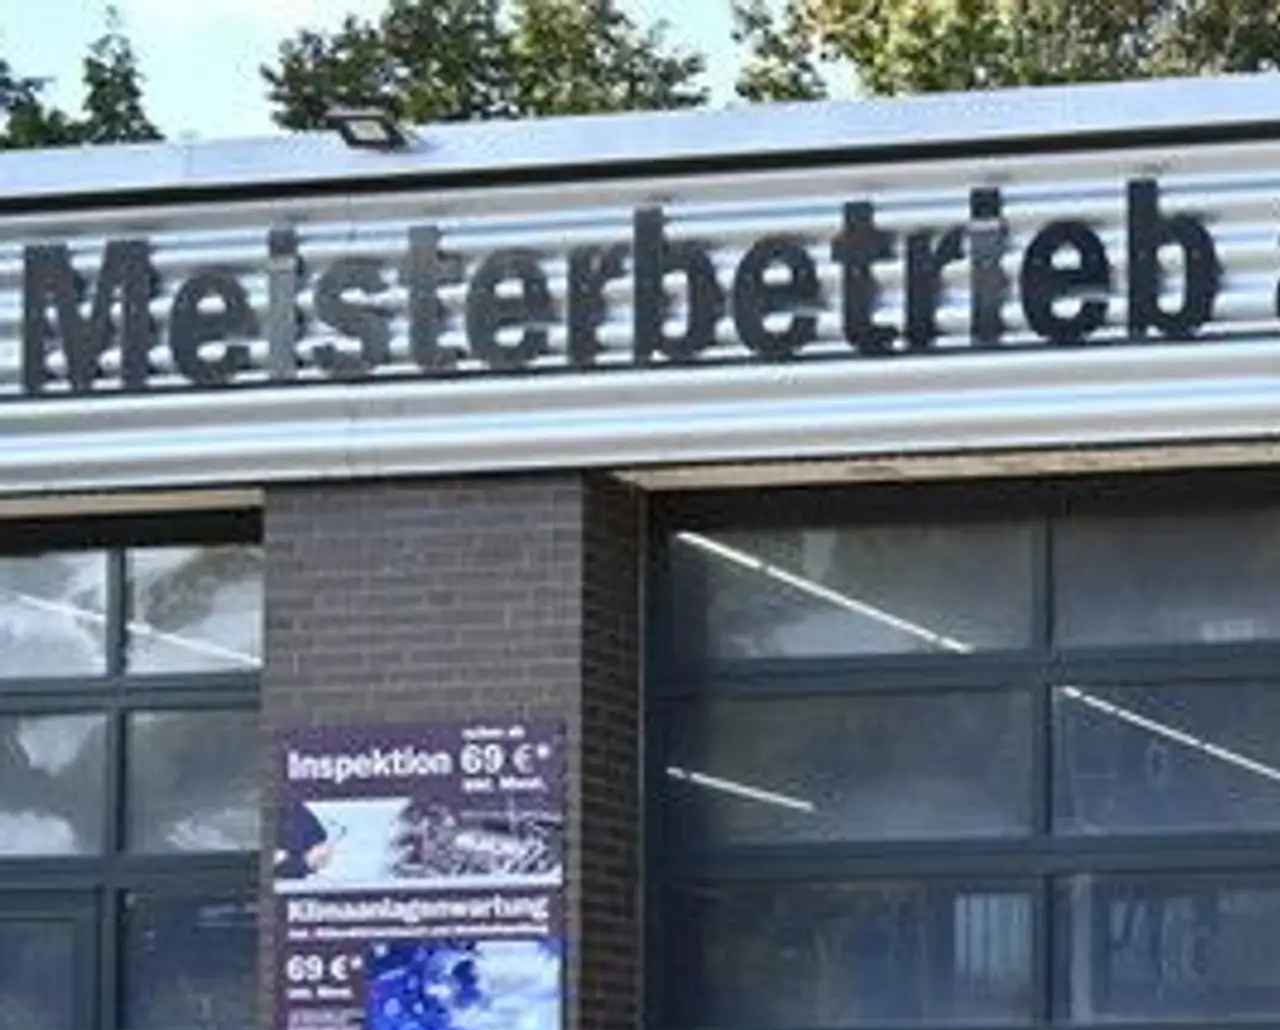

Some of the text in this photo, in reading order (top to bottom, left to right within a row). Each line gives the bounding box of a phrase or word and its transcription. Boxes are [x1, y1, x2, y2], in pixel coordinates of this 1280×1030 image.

[22, 176, 1224, 396] Meisterbetrieb
[287, 746, 453, 784] Inspektion
[460, 744, 503, 774] 69
[287, 893, 549, 923] Klimaanlagenwartung
[287, 954, 323, 982] 69
